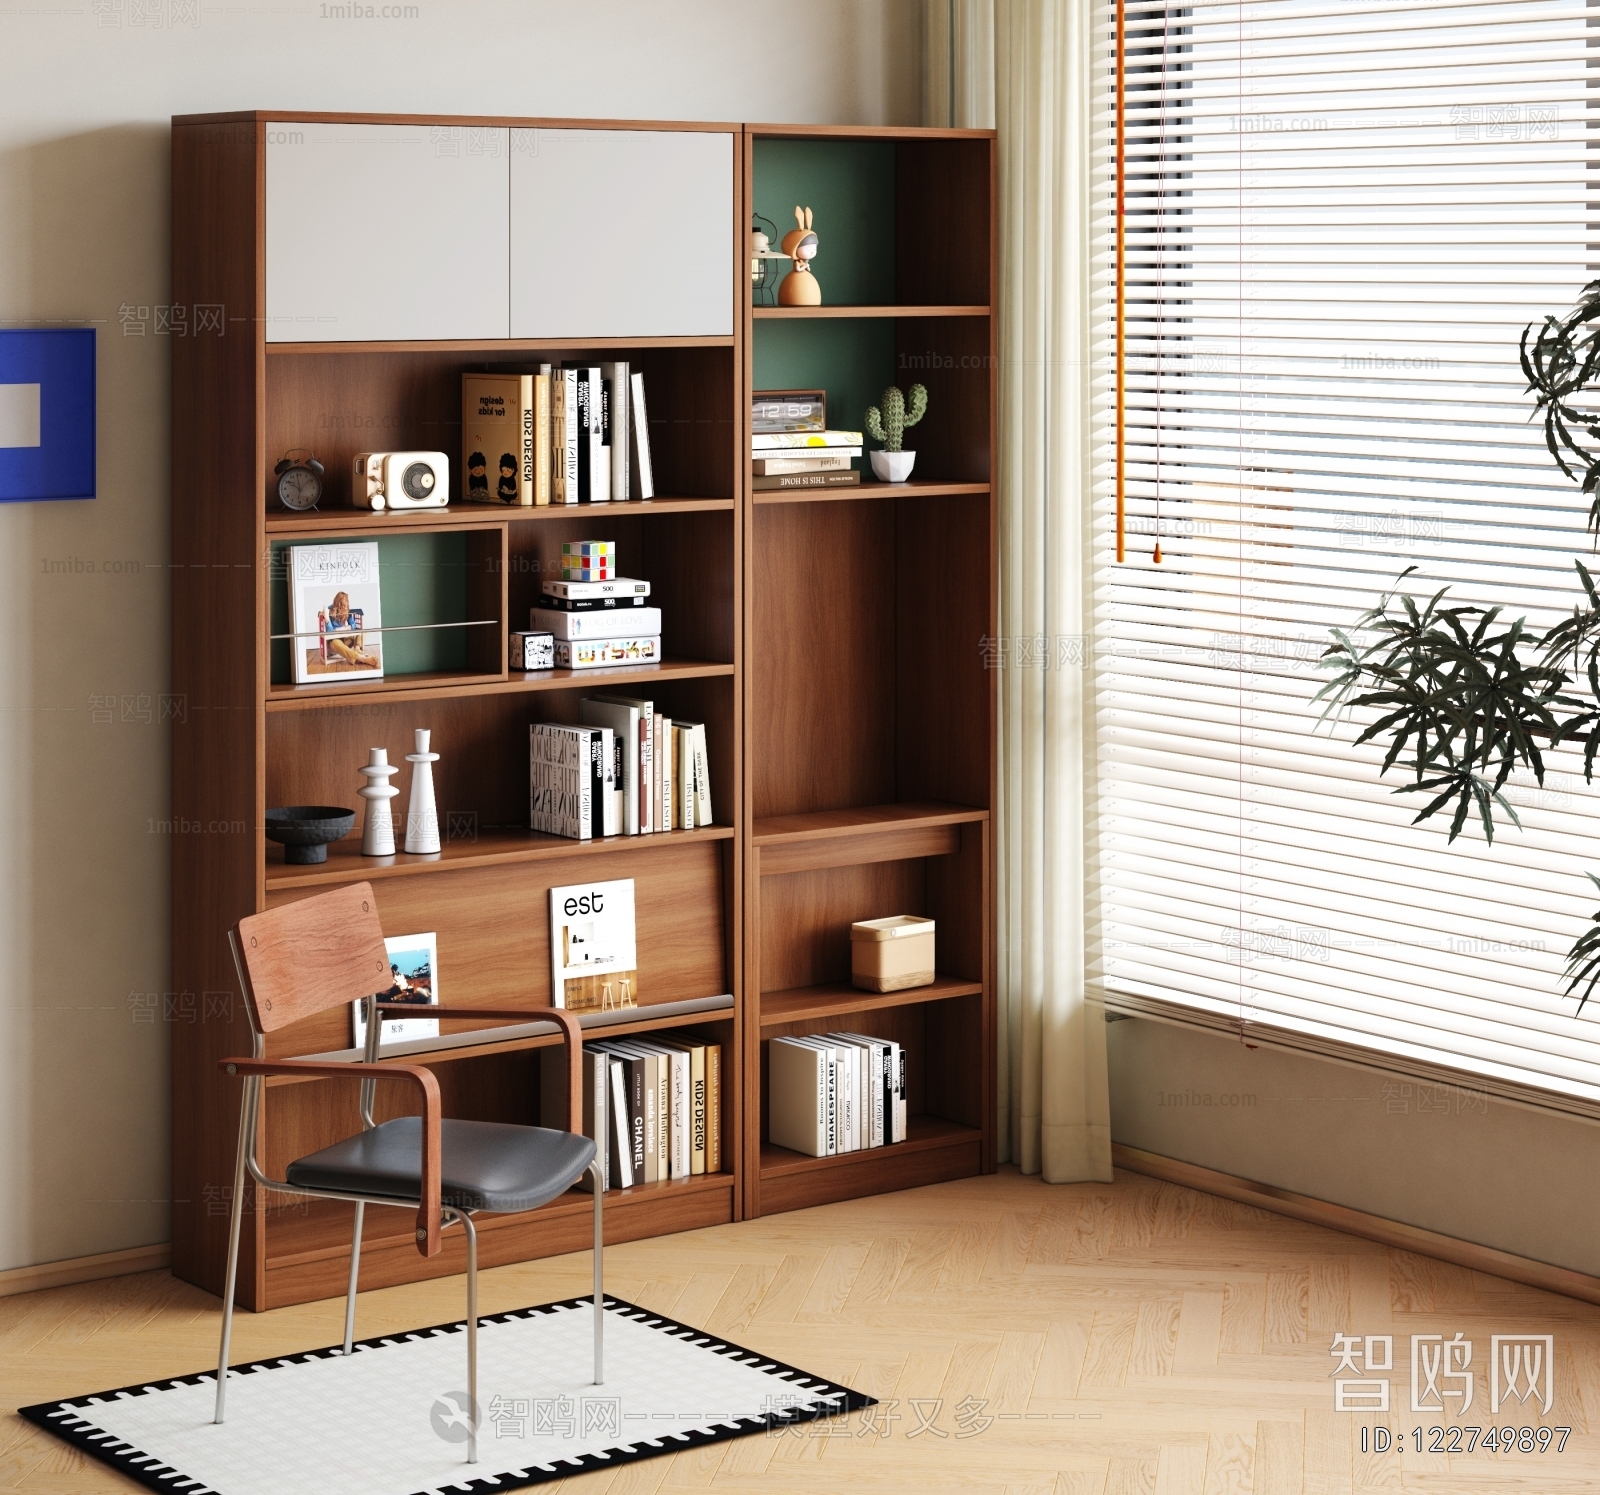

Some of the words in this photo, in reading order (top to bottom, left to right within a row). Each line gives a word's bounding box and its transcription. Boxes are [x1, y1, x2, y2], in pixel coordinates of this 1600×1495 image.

[821, 458, 841, 468] England
[780, 477, 801, 486] HOME
[802, 476, 809, 484] IS
[810, 476, 826, 484] THIS
[319, 561, 361, 571] KINFOLK
[584, 617, 605, 628] FOG
[606, 616, 620, 626] OF
[621, 615, 644, 625] LOVE
[699, 780, 705, 788] OF
[564, 892, 604, 917] est
[674, 1064, 682, 1080] The
[819, 1086, 824, 1095] to
[659, 1113, 668, 1159] Huffington
[634, 1117, 643, 1169] CHANEL
